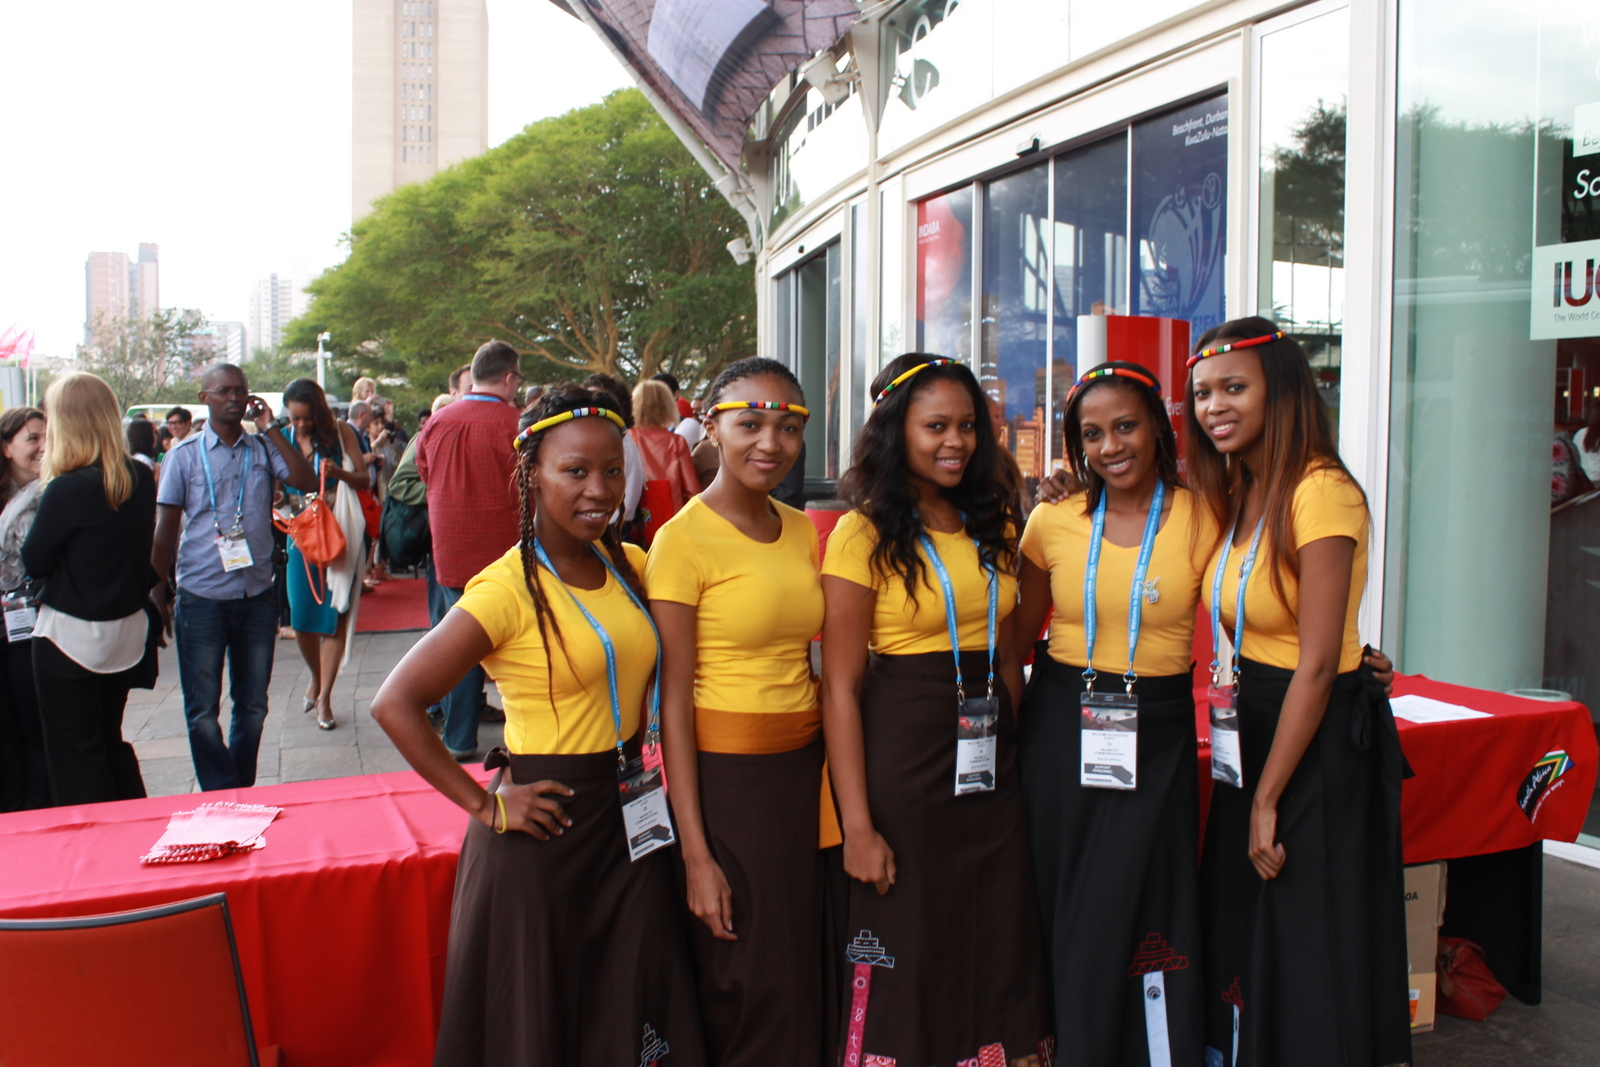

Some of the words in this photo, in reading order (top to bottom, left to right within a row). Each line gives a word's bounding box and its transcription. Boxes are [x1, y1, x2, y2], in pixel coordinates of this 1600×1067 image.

[918, 220, 940, 238] INDABA
[1553, 314, 1566, 323] The
[1568, 312, 1589, 321] World
